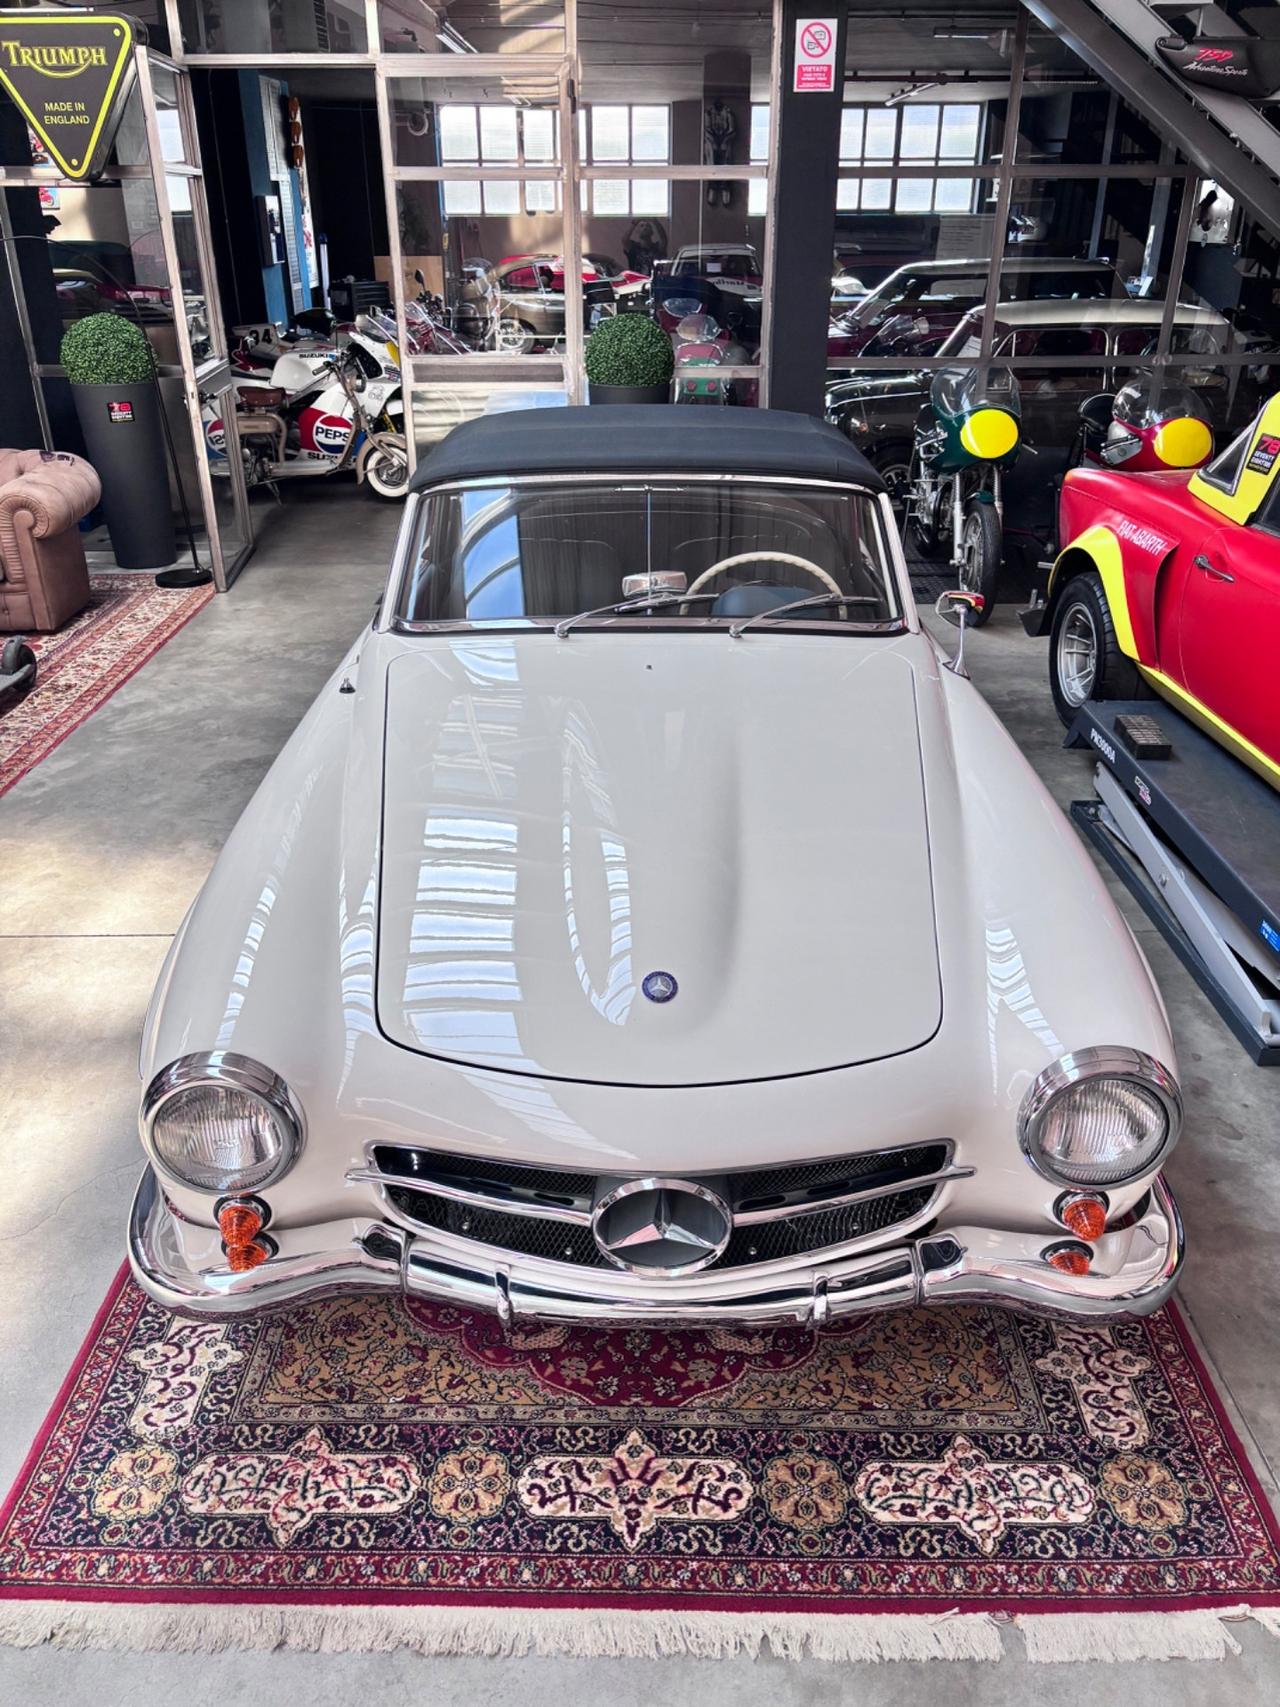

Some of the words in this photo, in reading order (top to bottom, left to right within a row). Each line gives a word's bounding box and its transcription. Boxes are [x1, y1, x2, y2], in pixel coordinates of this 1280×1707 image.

[1, 40, 108, 74] TRIUMPH
[44, 102, 73, 112] MADE
[75, 102, 86, 112] IN
[44, 115, 90, 125] ENGLAND
[298, 352, 329, 360] SUZUKI
[315, 426, 350, 442] PEPS
